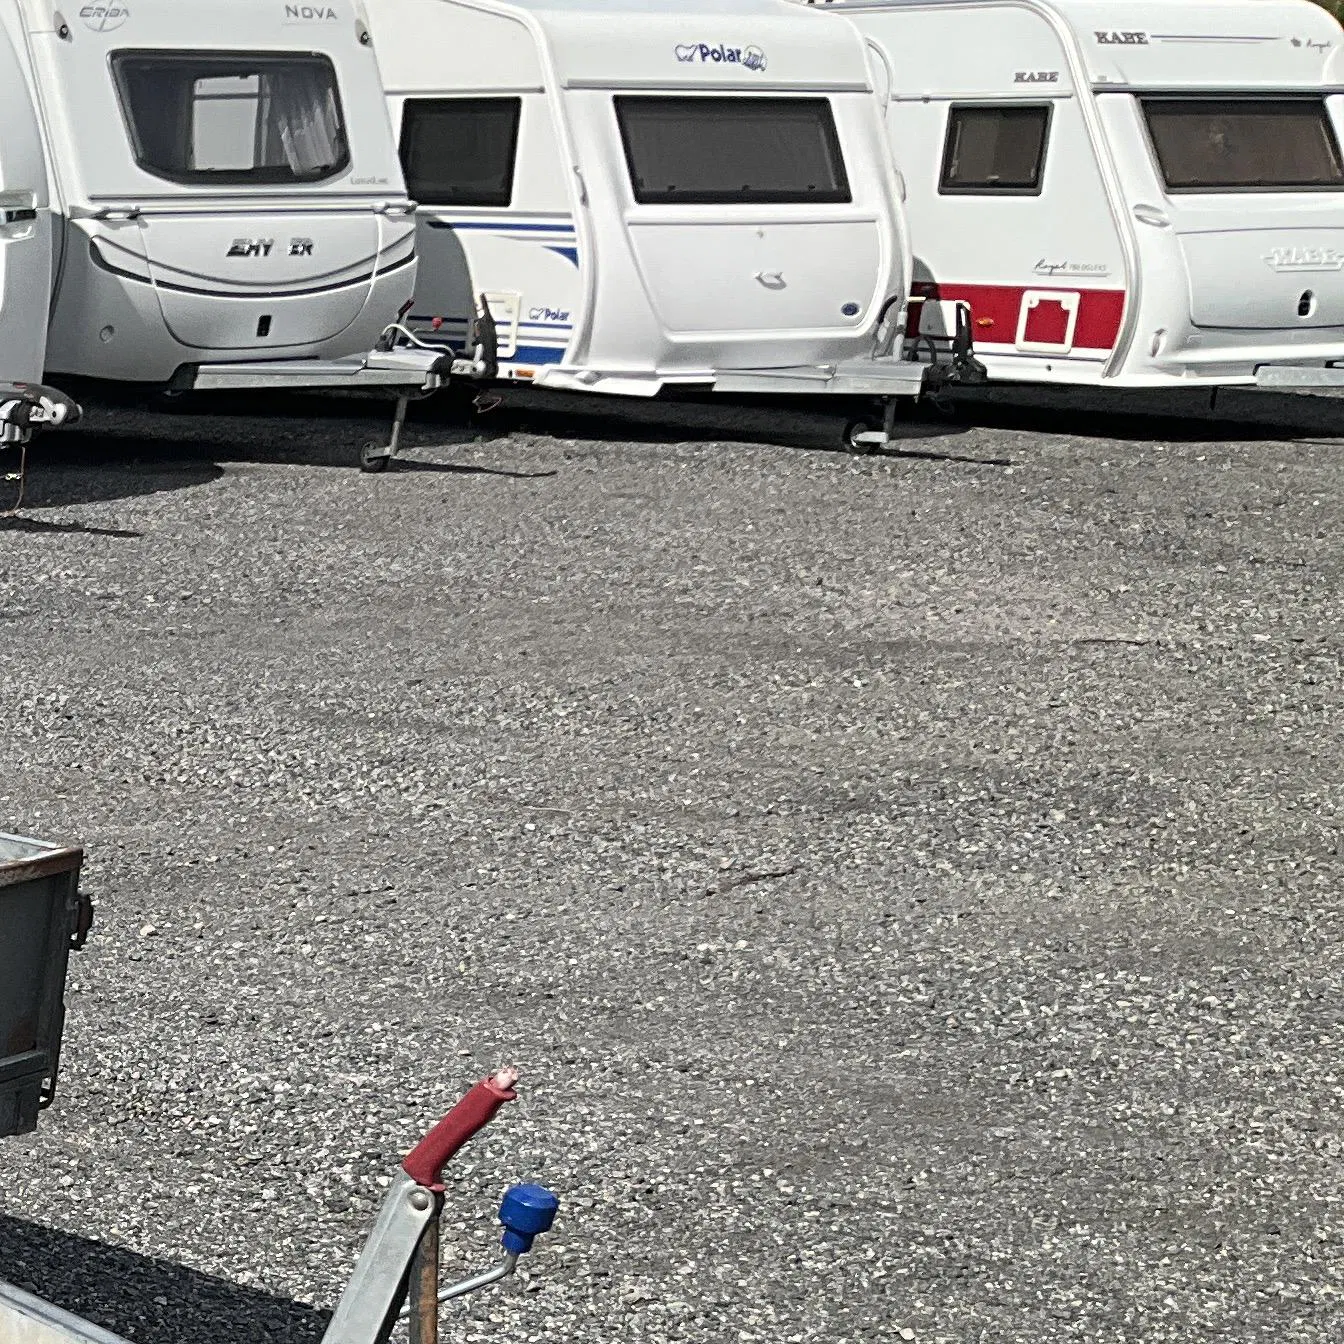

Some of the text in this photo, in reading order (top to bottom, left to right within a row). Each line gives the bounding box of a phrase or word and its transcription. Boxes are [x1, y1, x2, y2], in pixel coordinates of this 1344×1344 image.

[285, 4, 338, 19] NOVA
[1094, 31, 1149, 44] KABE
[699, 43, 742, 62] Polar
[1013, 71, 1060, 82] KABE
